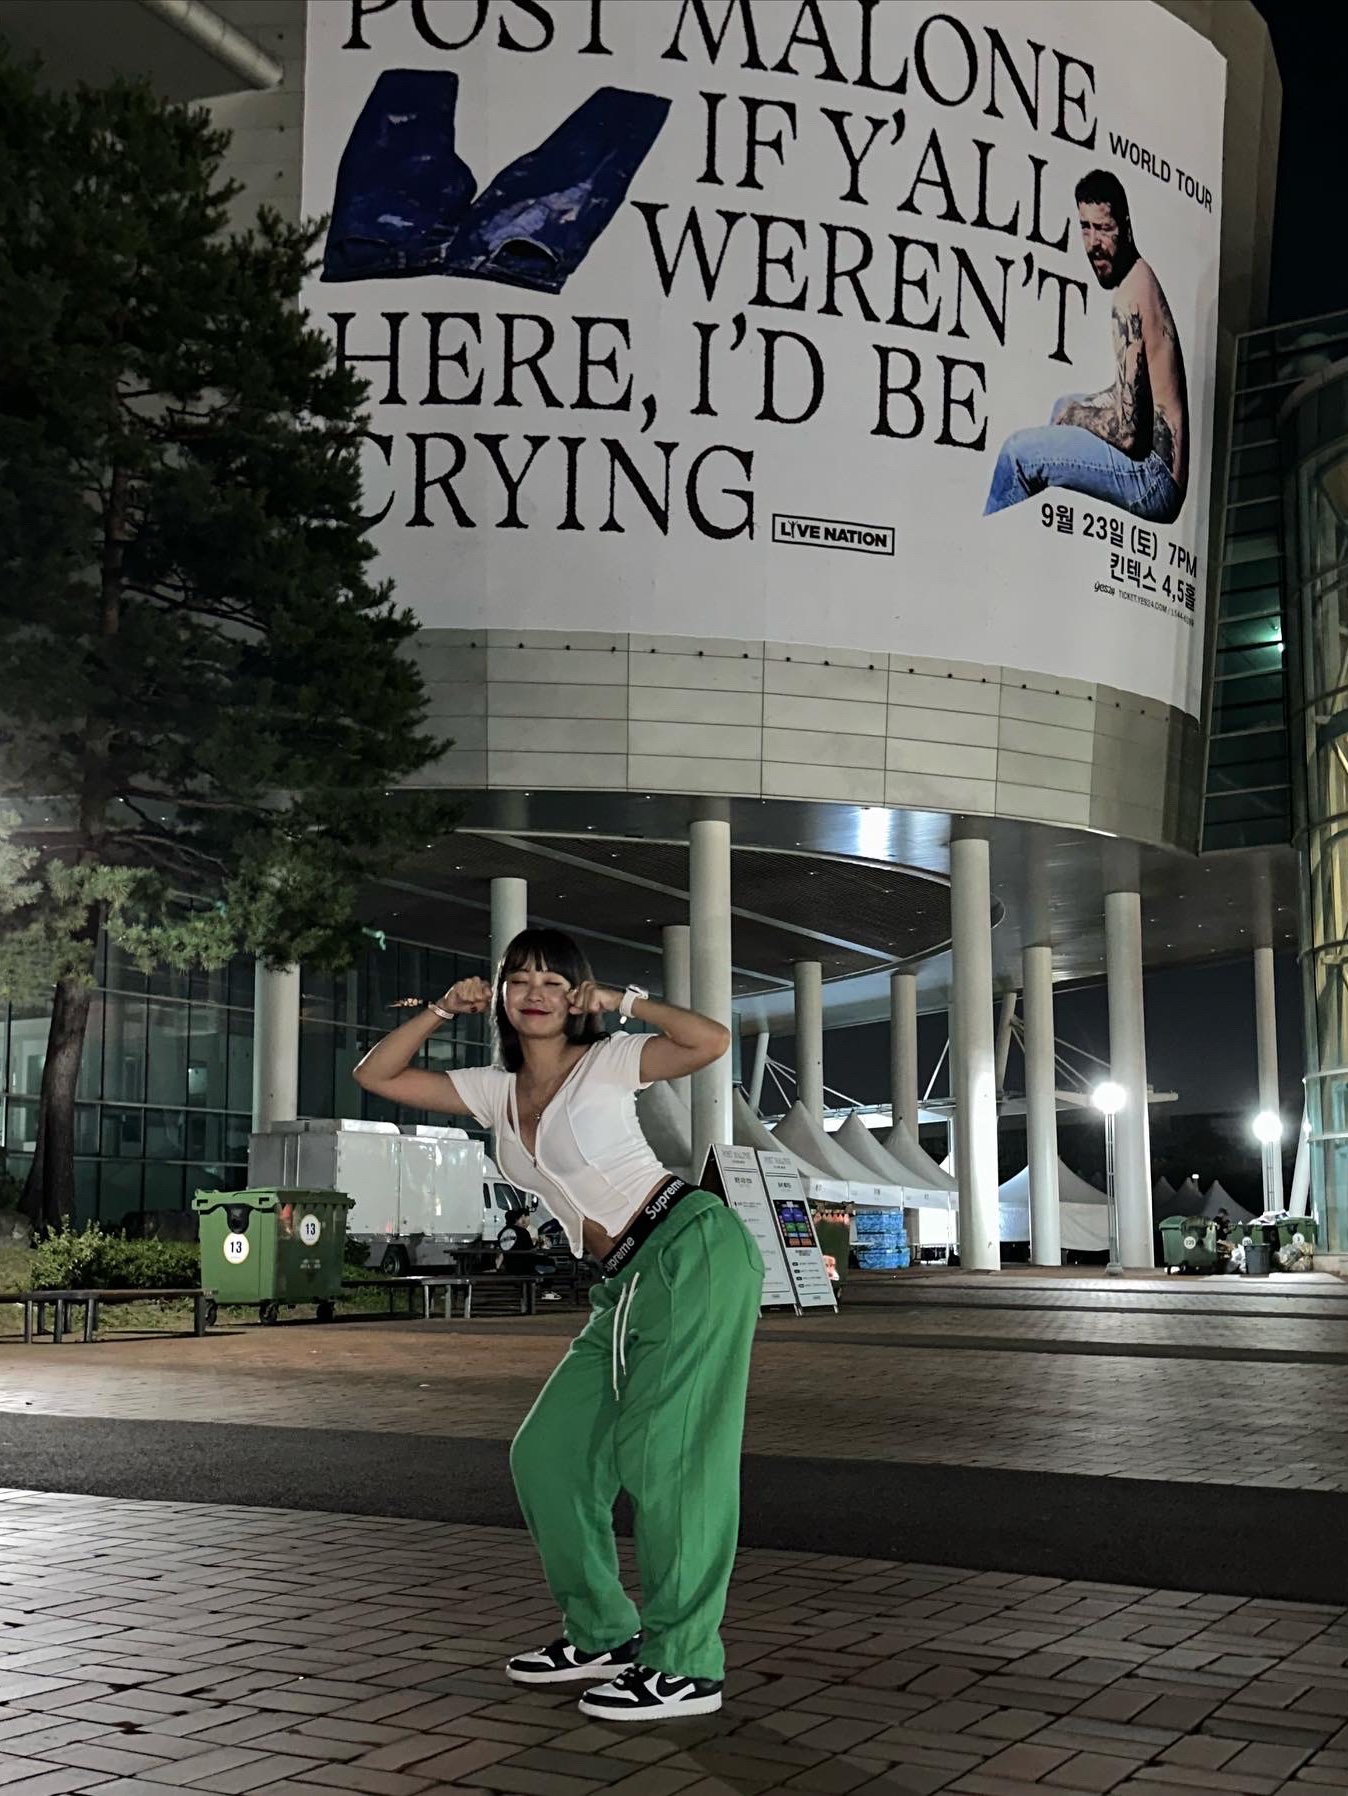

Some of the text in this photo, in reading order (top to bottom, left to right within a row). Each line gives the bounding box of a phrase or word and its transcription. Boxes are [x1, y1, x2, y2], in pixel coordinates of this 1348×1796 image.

[660, 0, 1097, 150] MALONE
[697, 91, 1071, 252] IF Y'ALL
[1109, 132, 1212, 213] WORLD TOUR
[630, 200, 1088, 364] WEREN'T
[327, 312, 988, 452] HERE, I'D BE
[824, 527, 887, 547] NATION
[1041, 503, 1198, 578] 9월 23일 (토) 7PM
[1110, 552, 1157, 593] 킨텍스
[230, 1241, 242, 1254] 13
[305, 1223, 316, 1236] 13
